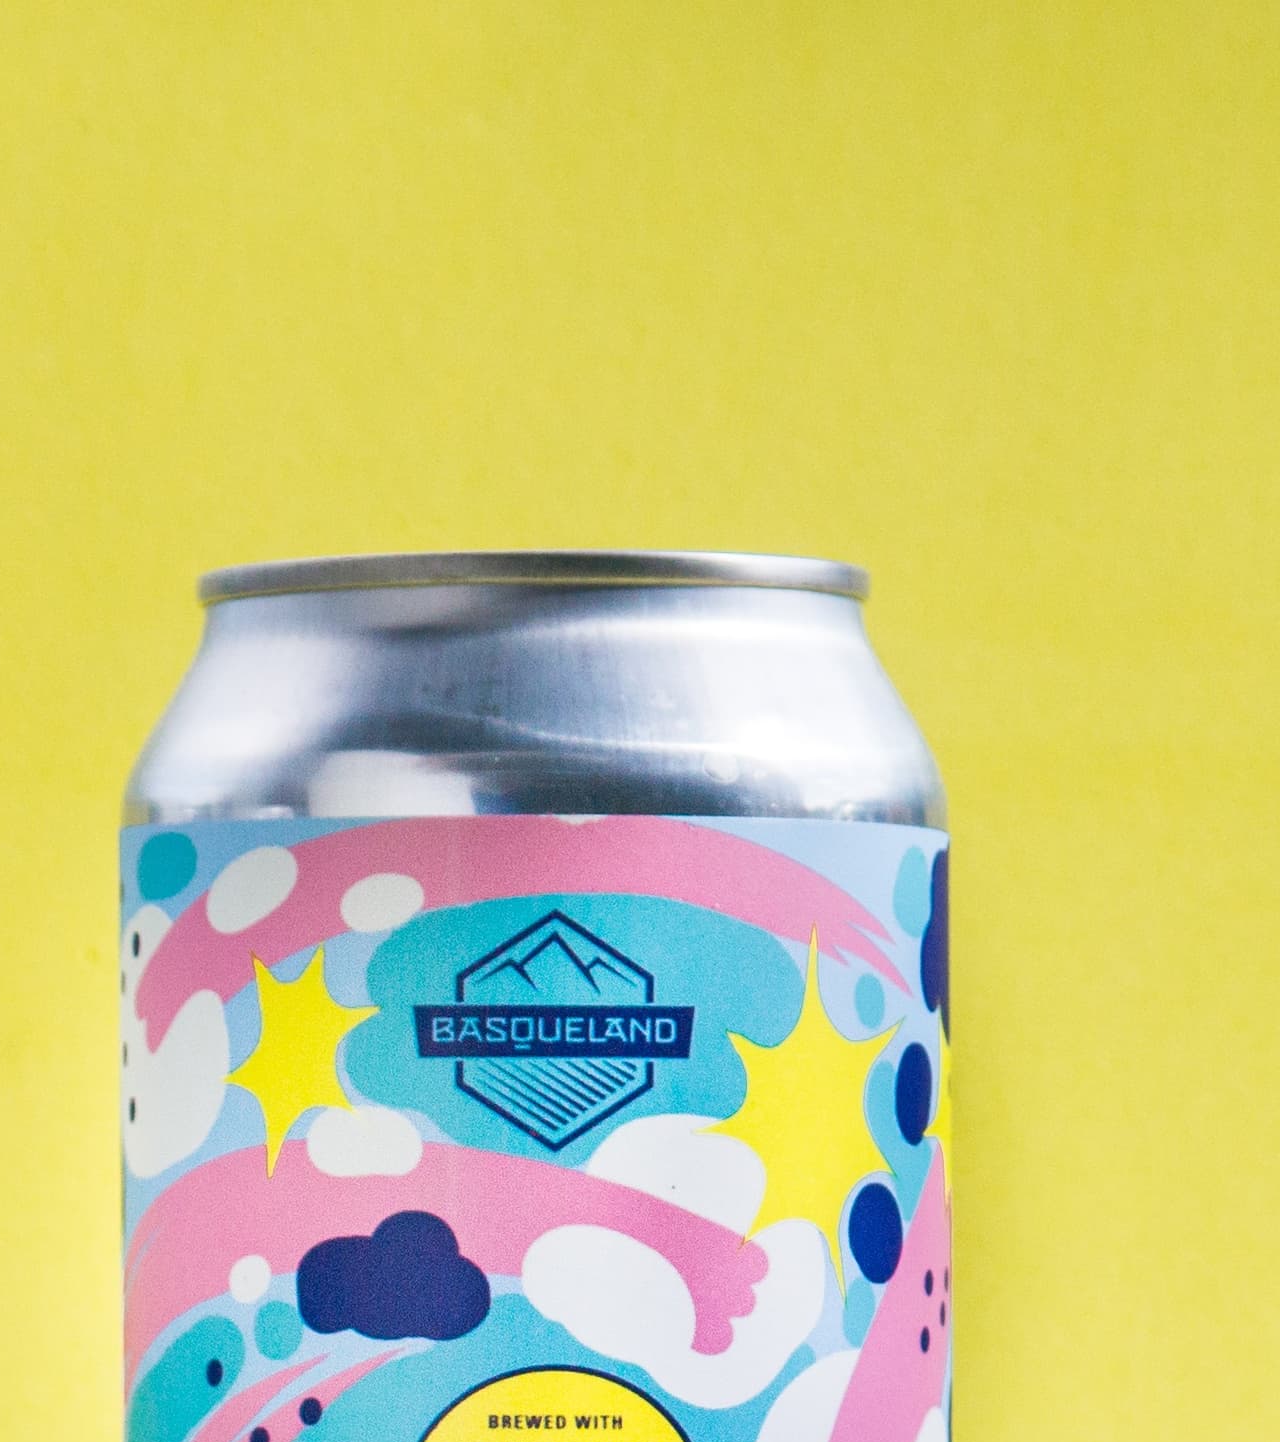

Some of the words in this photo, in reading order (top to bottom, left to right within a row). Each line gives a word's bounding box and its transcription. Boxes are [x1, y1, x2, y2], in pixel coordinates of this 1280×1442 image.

[431, 1016, 677, 1050] BASQUELAND
[488, 1414, 567, 1430] BREWED
[574, 1415, 623, 1430] WITH
